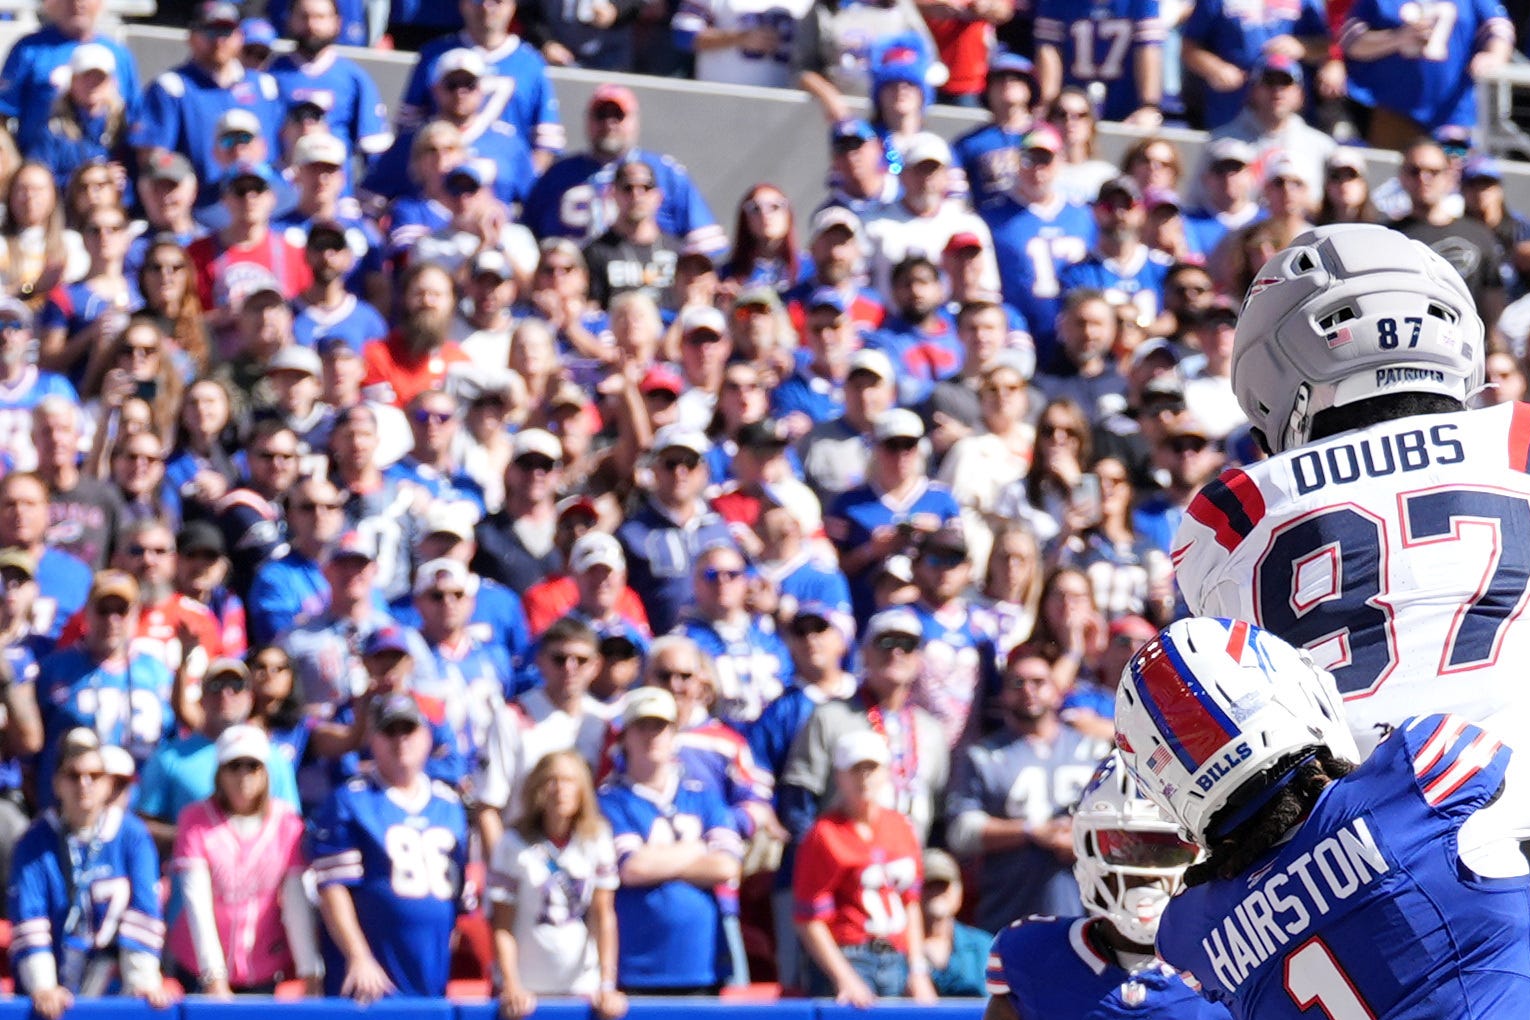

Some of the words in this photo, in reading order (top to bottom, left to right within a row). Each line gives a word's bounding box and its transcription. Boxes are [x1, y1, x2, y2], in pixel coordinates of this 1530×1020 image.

[1070, 19, 1131, 79] 17
[1376, 316, 1423, 350] 87
[1290, 422, 1466, 496] DOUBS
[1194, 741, 1253, 793] BILLS
[1201, 817, 1390, 993] HAIRSTON
